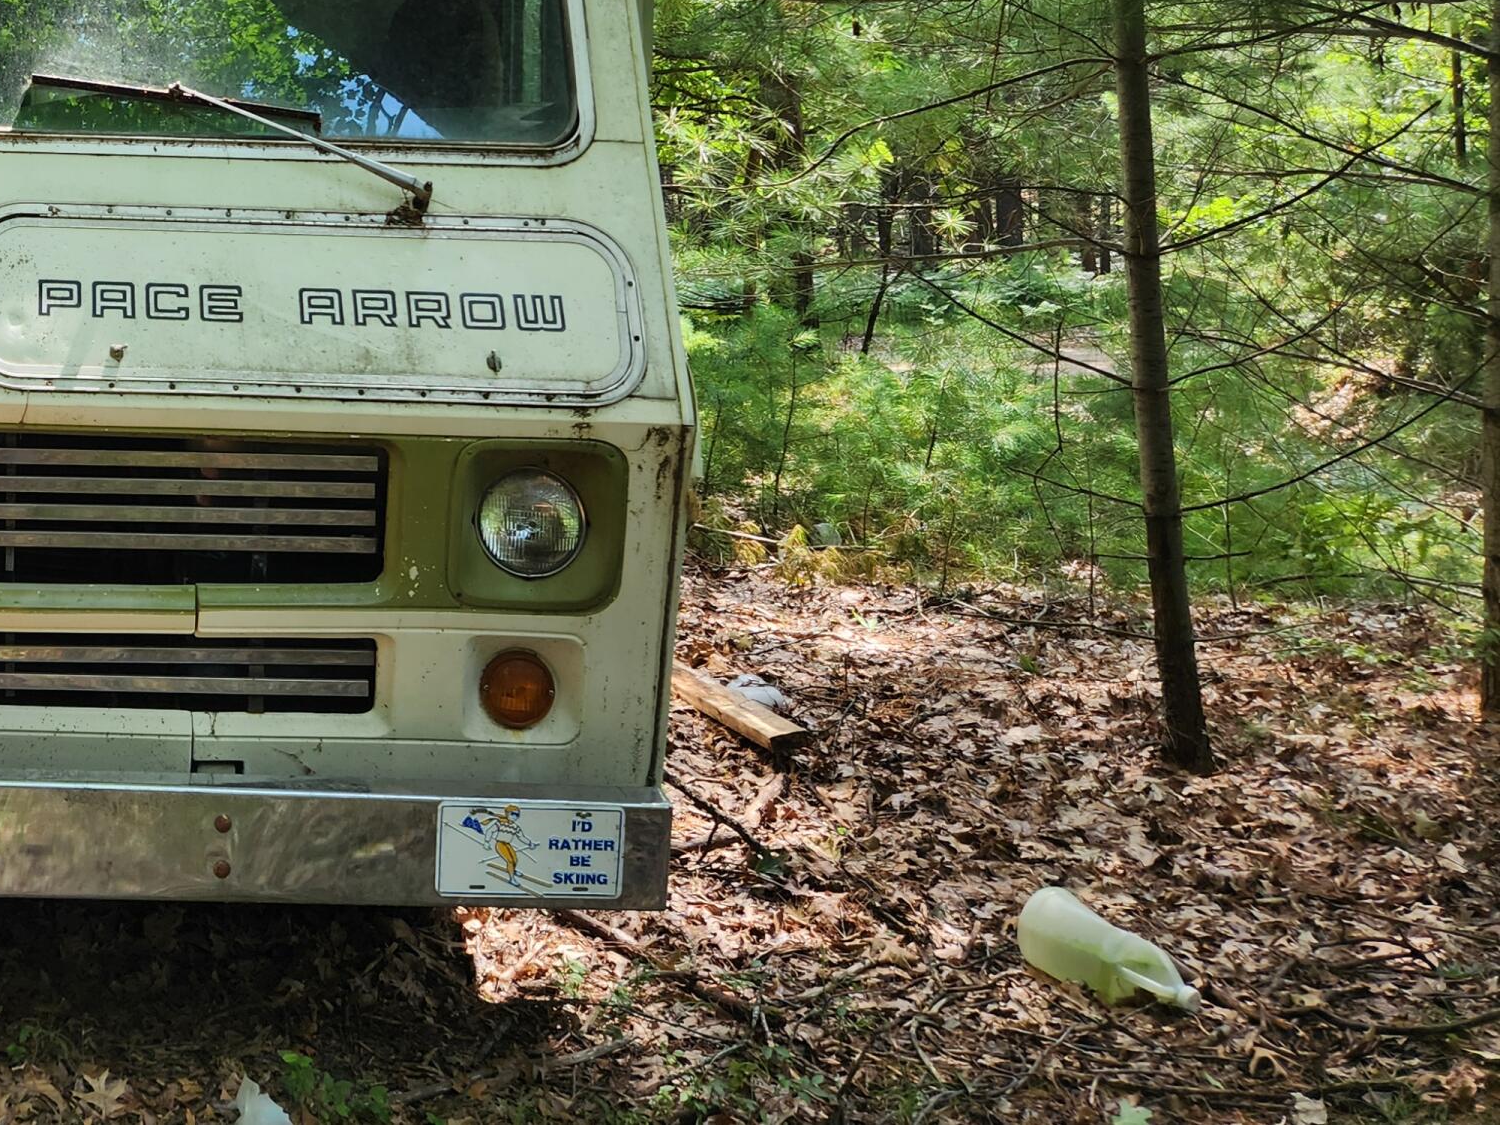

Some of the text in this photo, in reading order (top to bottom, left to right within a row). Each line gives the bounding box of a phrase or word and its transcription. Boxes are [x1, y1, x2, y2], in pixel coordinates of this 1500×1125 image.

[38, 279, 566, 332] PACE ARROW
[572, 820, 593, 832] I'D
[548, 838, 615, 851] RATHER
[569, 855, 591, 867] BE
[552, 872, 608, 885] SKIING
